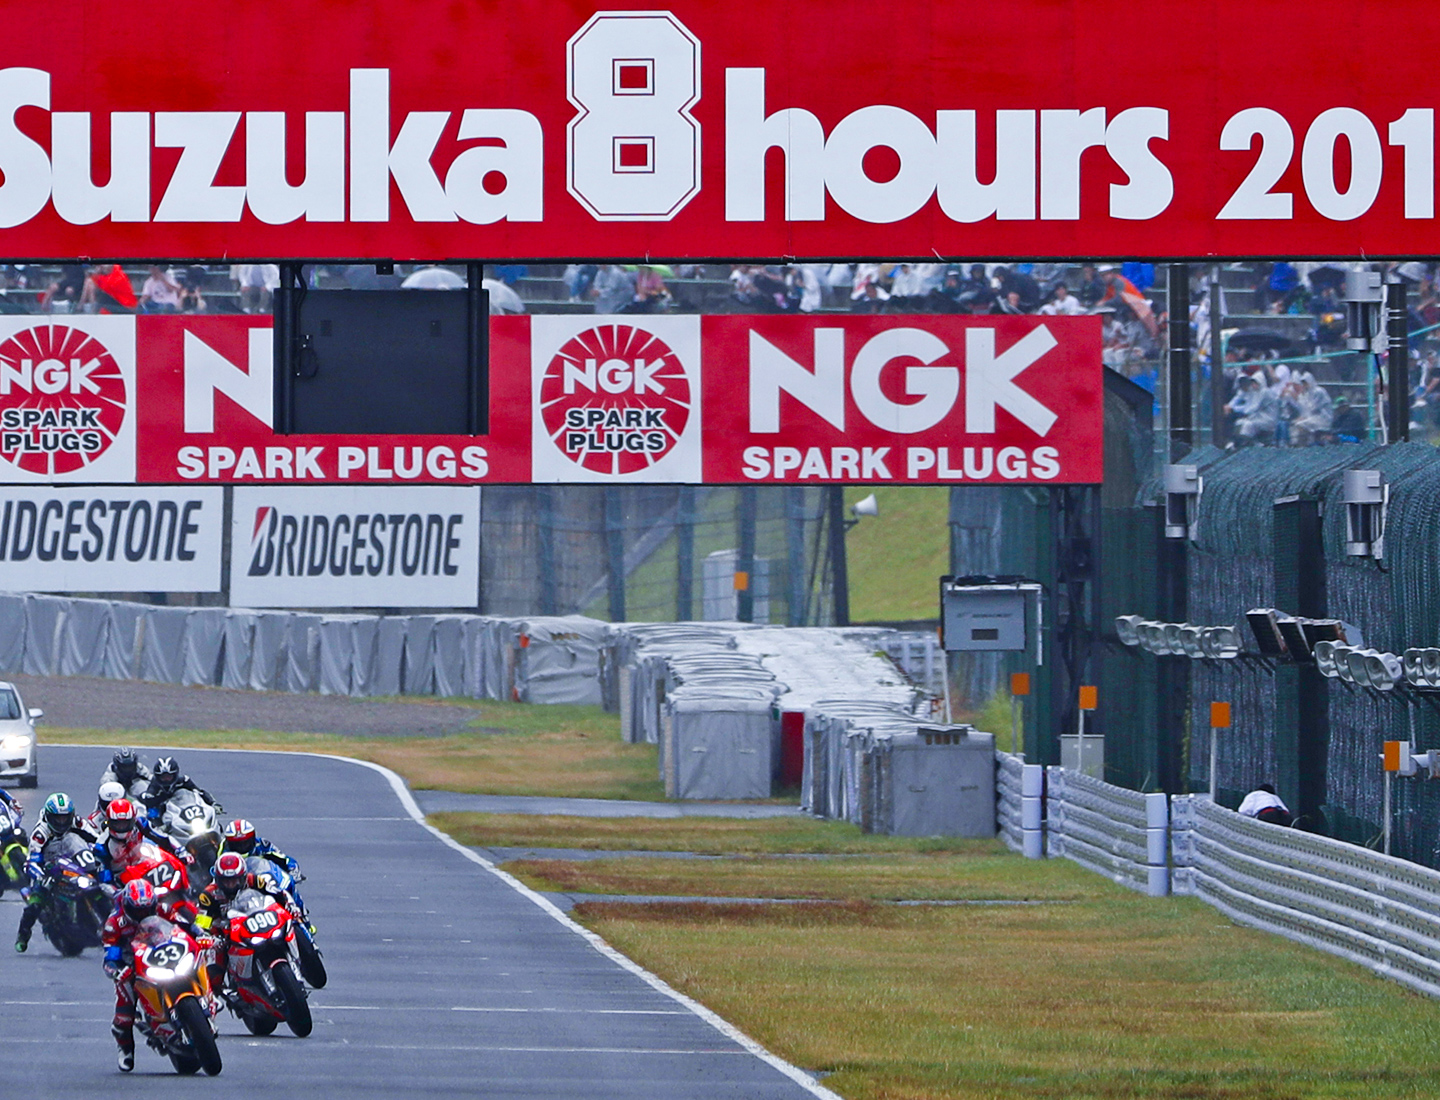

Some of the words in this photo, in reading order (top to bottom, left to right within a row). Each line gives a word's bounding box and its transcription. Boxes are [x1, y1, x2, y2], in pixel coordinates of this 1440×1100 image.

[567, 10, 702, 222] 8
[725, 67, 1174, 224] hours
[0, 357, 102, 396] NGK
[562, 356, 667, 395] NGK
[749, 323, 1059, 438] NGK
[2, 408, 100, 430] SPARK
[566, 408, 664, 430] SPARK
[3, 431, 101, 453] PLUGS
[567, 431, 666, 453] PLUGS
[176, 445, 324, 480] SPARK
[337, 445, 490, 480] PLUGS
[742, 445, 892, 480] SPARK
[906, 445, 1060, 480] PLUGS
[247, 506, 464, 577] BRIDGESTONE
[184, 806, 203, 820] 02
[75, 850, 95, 868] 10
[147, 864, 173, 886] 72
[246, 911, 277, 933] 090
[154, 944, 181, 966] 33
